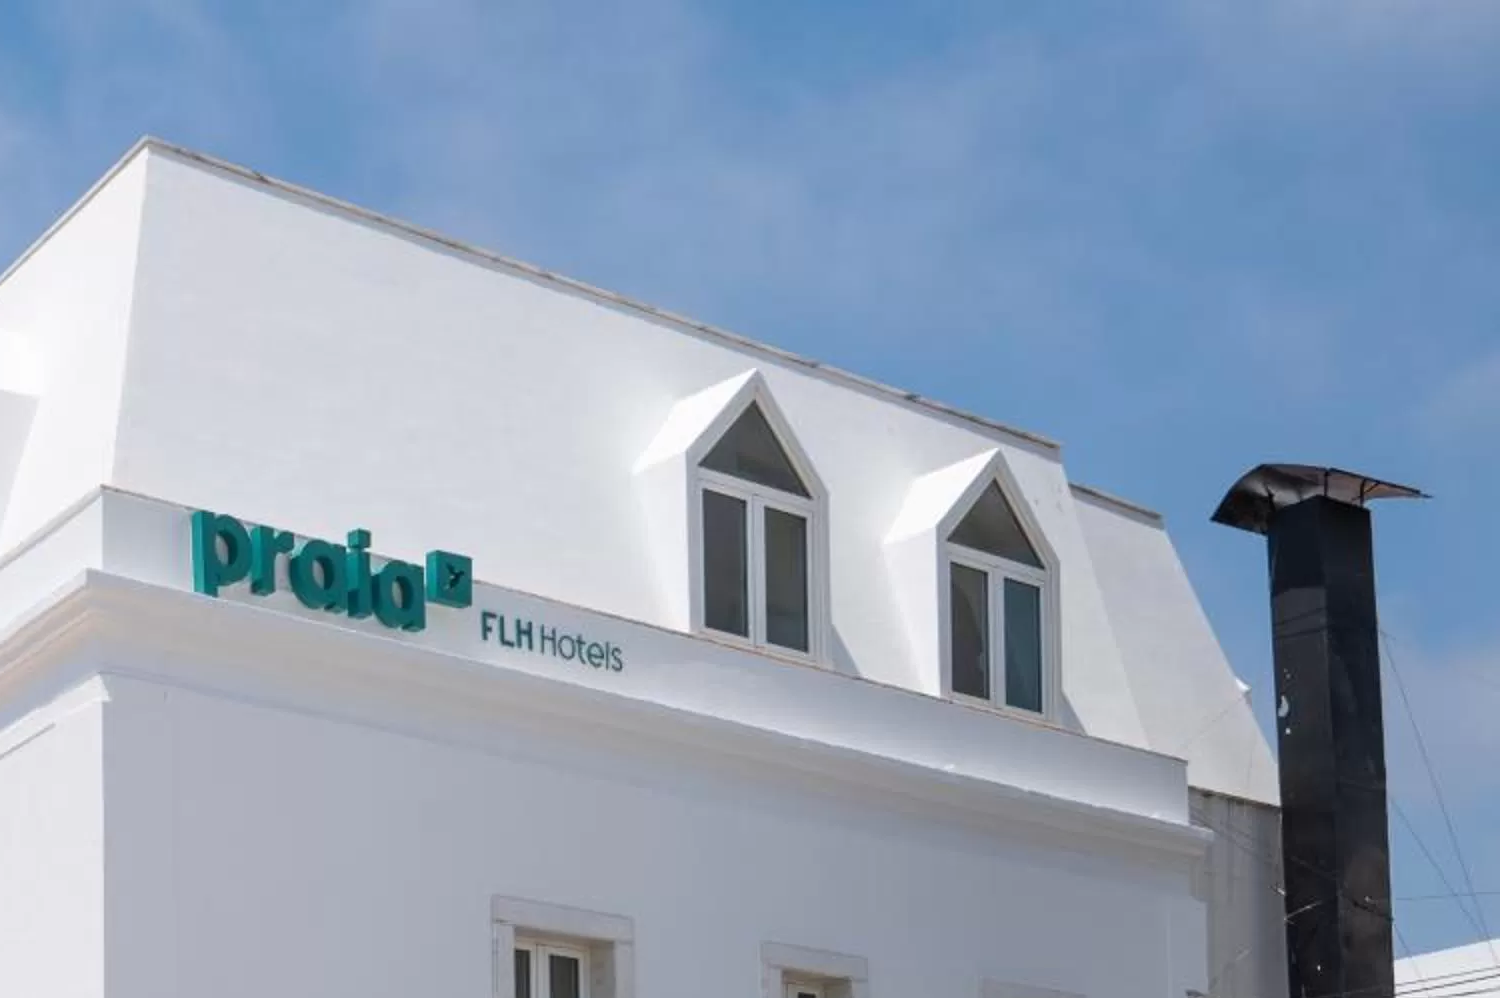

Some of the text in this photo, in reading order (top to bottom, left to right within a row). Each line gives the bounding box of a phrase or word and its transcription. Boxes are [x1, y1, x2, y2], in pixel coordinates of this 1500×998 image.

[191, 509, 426, 632] praia
[481, 611, 623, 672] FLH Hotels
